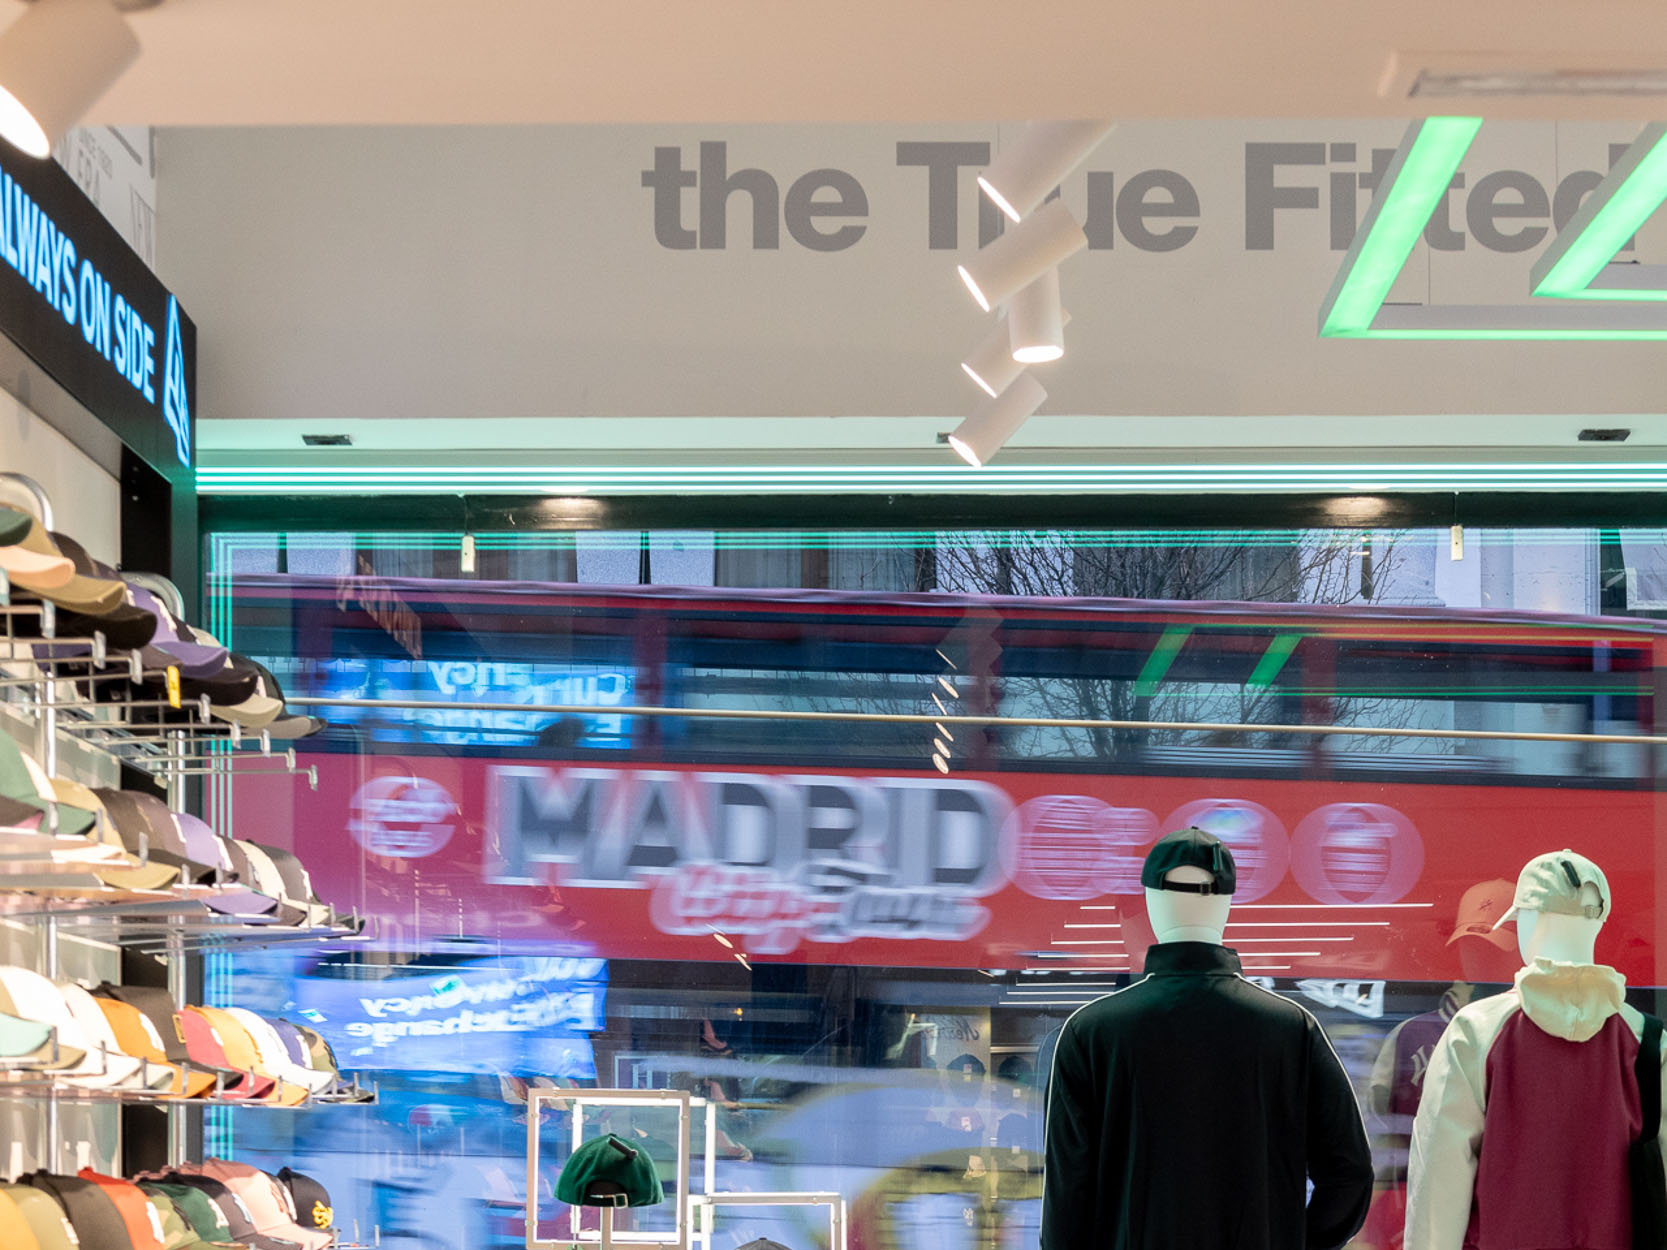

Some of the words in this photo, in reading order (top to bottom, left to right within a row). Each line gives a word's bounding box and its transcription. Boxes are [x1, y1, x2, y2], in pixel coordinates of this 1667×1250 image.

[641, 141, 869, 252] the
[0, 166, 77, 326] LWAYS
[79, 259, 111, 362] ON
[113, 293, 156, 404] SIDE
[485, 765, 1018, 896] MADRID
